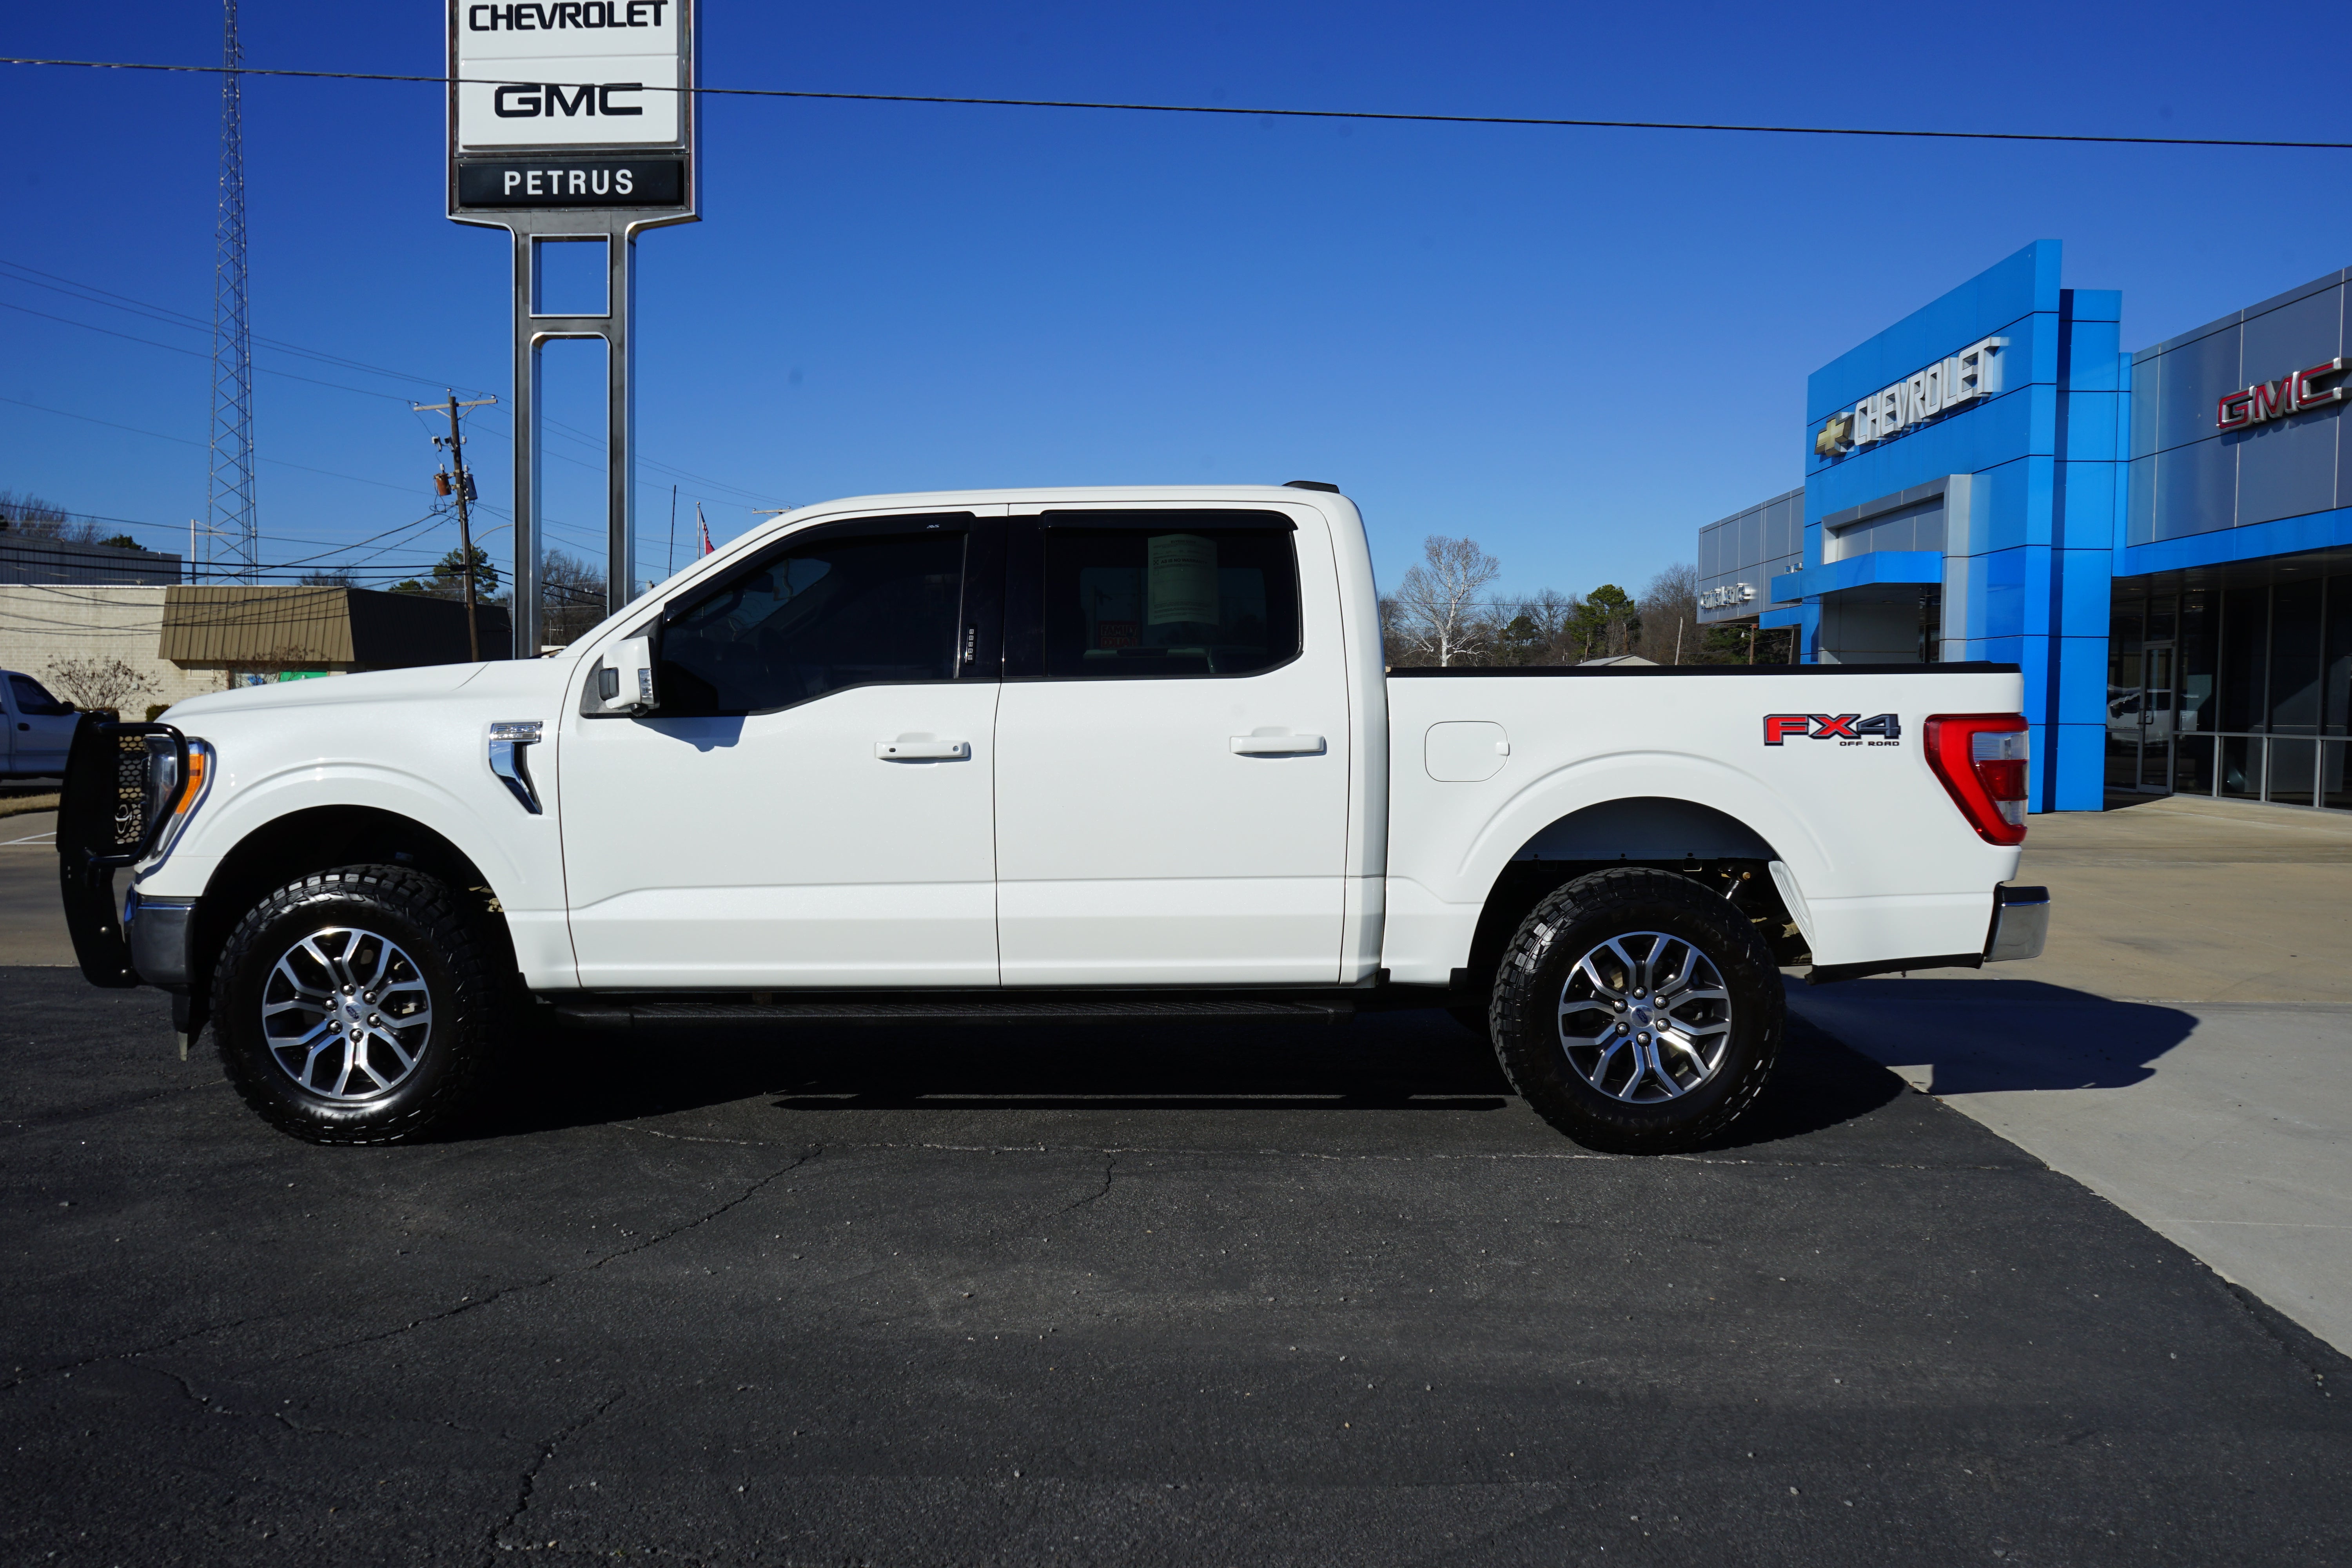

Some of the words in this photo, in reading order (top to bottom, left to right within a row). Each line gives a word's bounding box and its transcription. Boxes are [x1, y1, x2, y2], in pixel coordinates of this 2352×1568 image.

[469, 0, 668, 31] CHEVROLET
[494, 83, 642, 118] GMC
[505, 169, 633, 195] PETRUS
[1854, 336, 2002, 446] CHEVROLET
[2216, 357, 2342, 431] GMC
[495, 725, 536, 733] F-150
[1763, 714, 1901, 746] FX4
